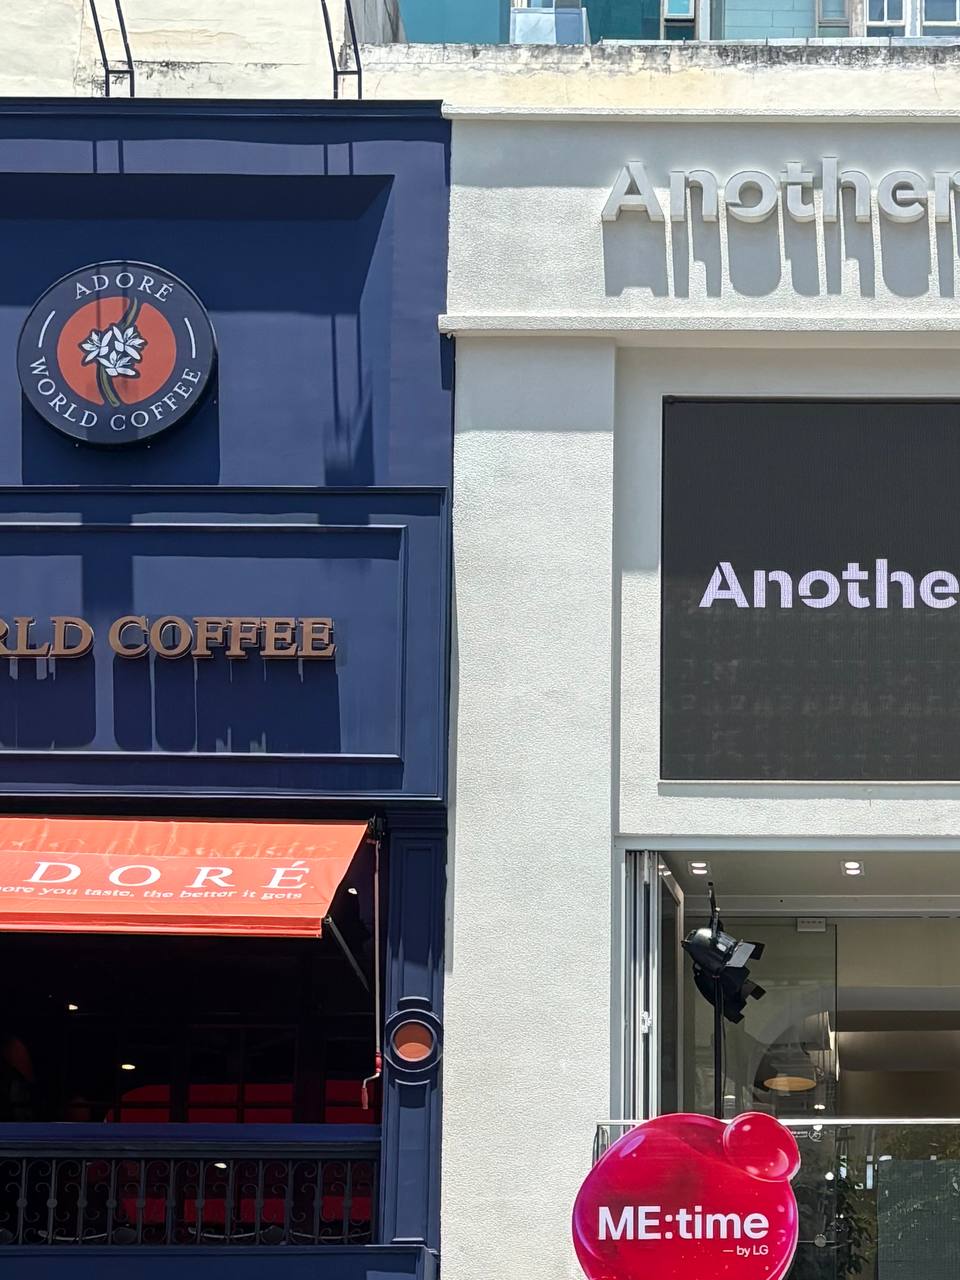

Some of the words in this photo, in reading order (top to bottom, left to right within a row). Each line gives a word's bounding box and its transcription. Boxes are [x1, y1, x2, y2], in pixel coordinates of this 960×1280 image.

[74, 272, 173, 301] ADORÉ
[29, 356, 98, 428] WORLD
[110, 367, 201, 431] COFFEE
[0, 616, 95, 659] LD
[108, 615, 336, 659] COFFEE
[597, 1205, 770, 1241] ME:time
[736, 1244, 750, 1258] by
[752, 1245, 769, 1256] LG
